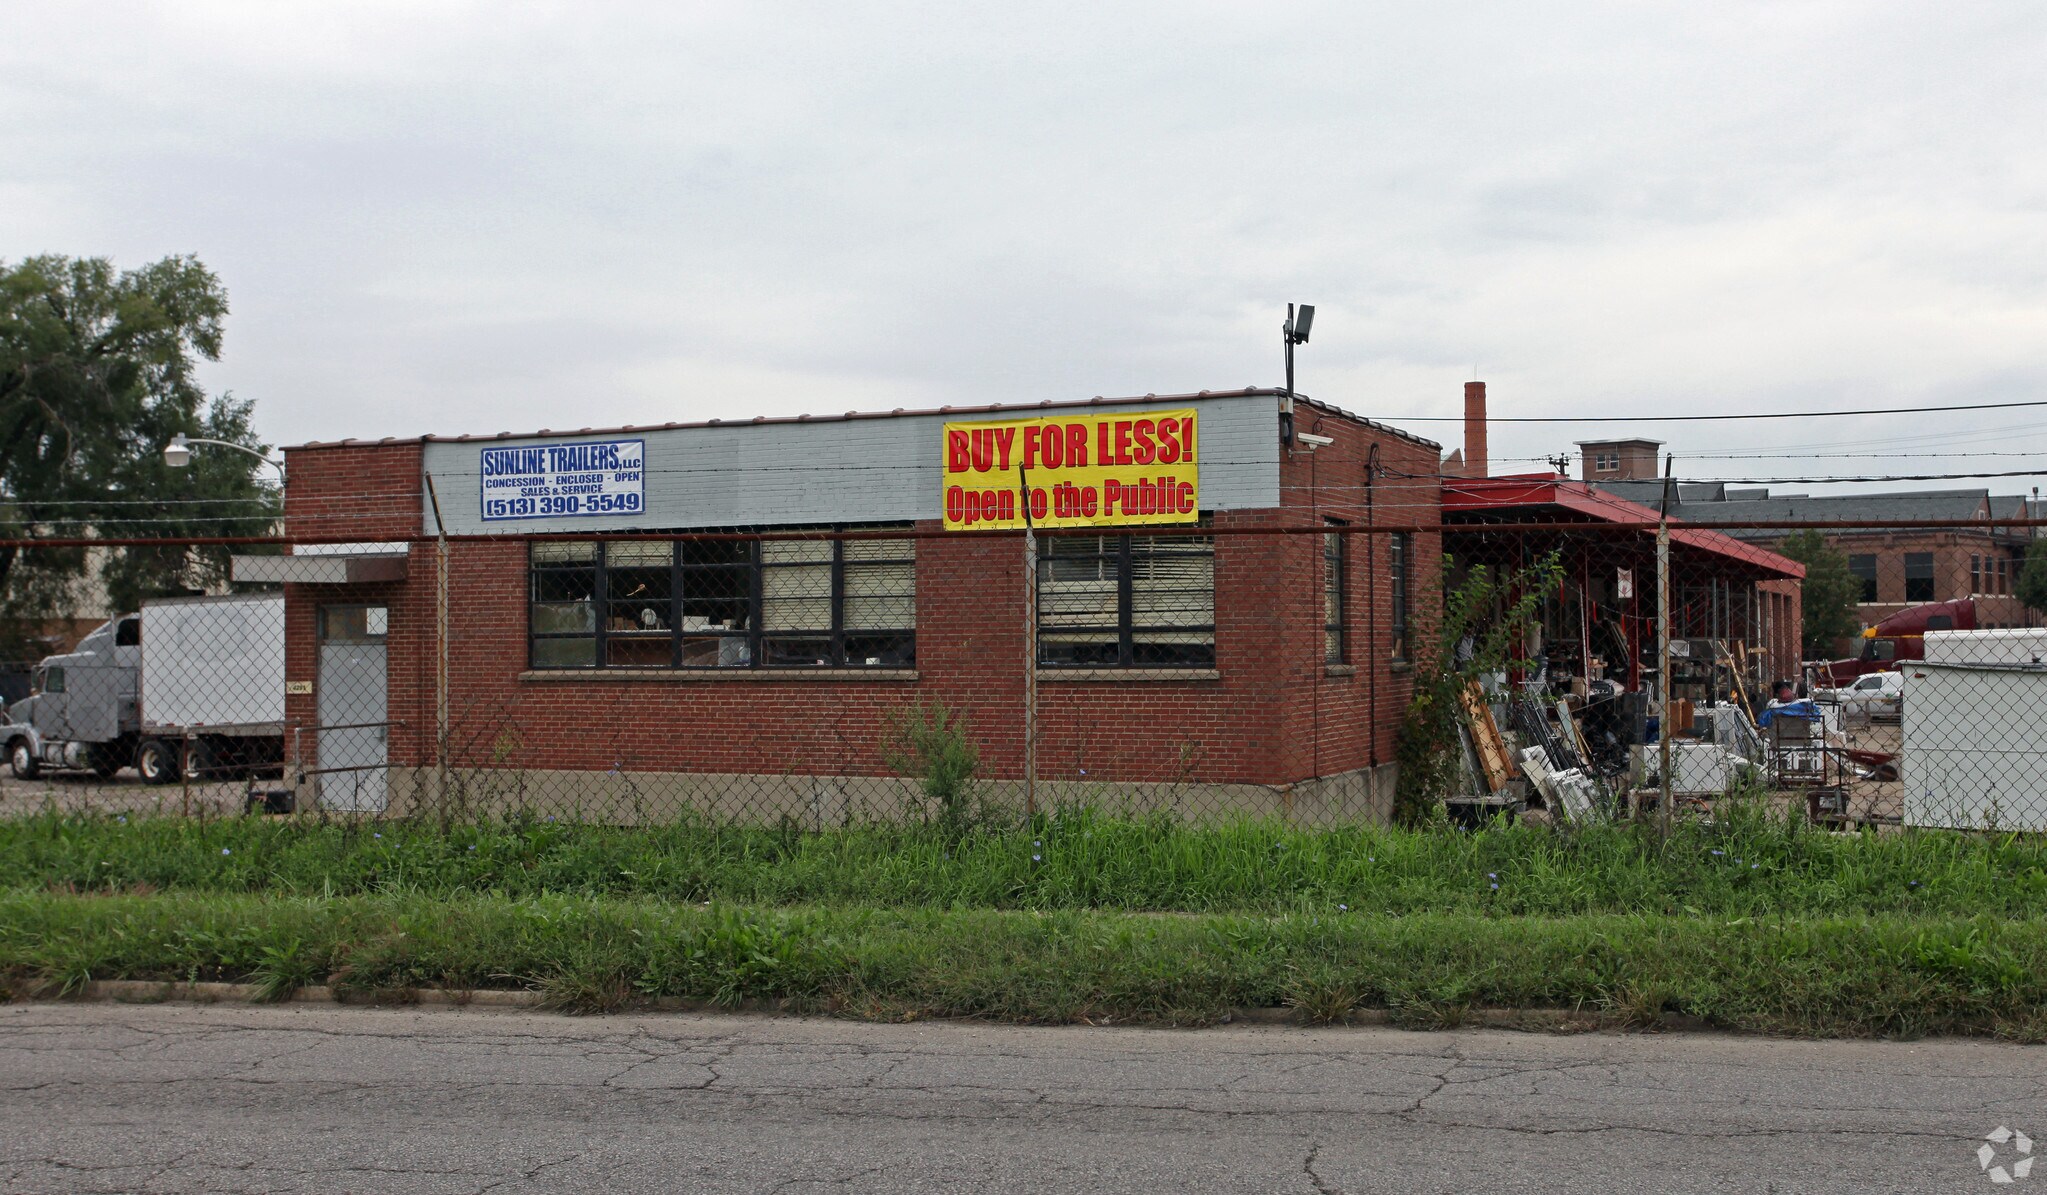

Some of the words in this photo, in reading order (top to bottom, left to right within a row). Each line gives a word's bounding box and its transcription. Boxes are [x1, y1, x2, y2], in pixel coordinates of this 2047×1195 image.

[948, 427, 1016, 473] BUY
[1023, 423, 1088, 470] FOR
[1097, 417, 1194, 466] LESS!
[484, 448, 546, 476] SUNLINE
[623, 458, 641, 469] LLC
[486, 476, 545, 488] CONCESSION
[556, 473, 603, 485] ENCLOSED
[614, 471, 640, 482] OPEN
[520, 486, 551, 497] SALES
[552, 487, 559, 495] &
[561, 484, 603, 495] SERVICE
[539, 492, 640, 514] 390-5549
[946, 484, 1015, 526] Open
[1053, 481, 1098, 519] the
[1104, 476, 1194, 517] Public
